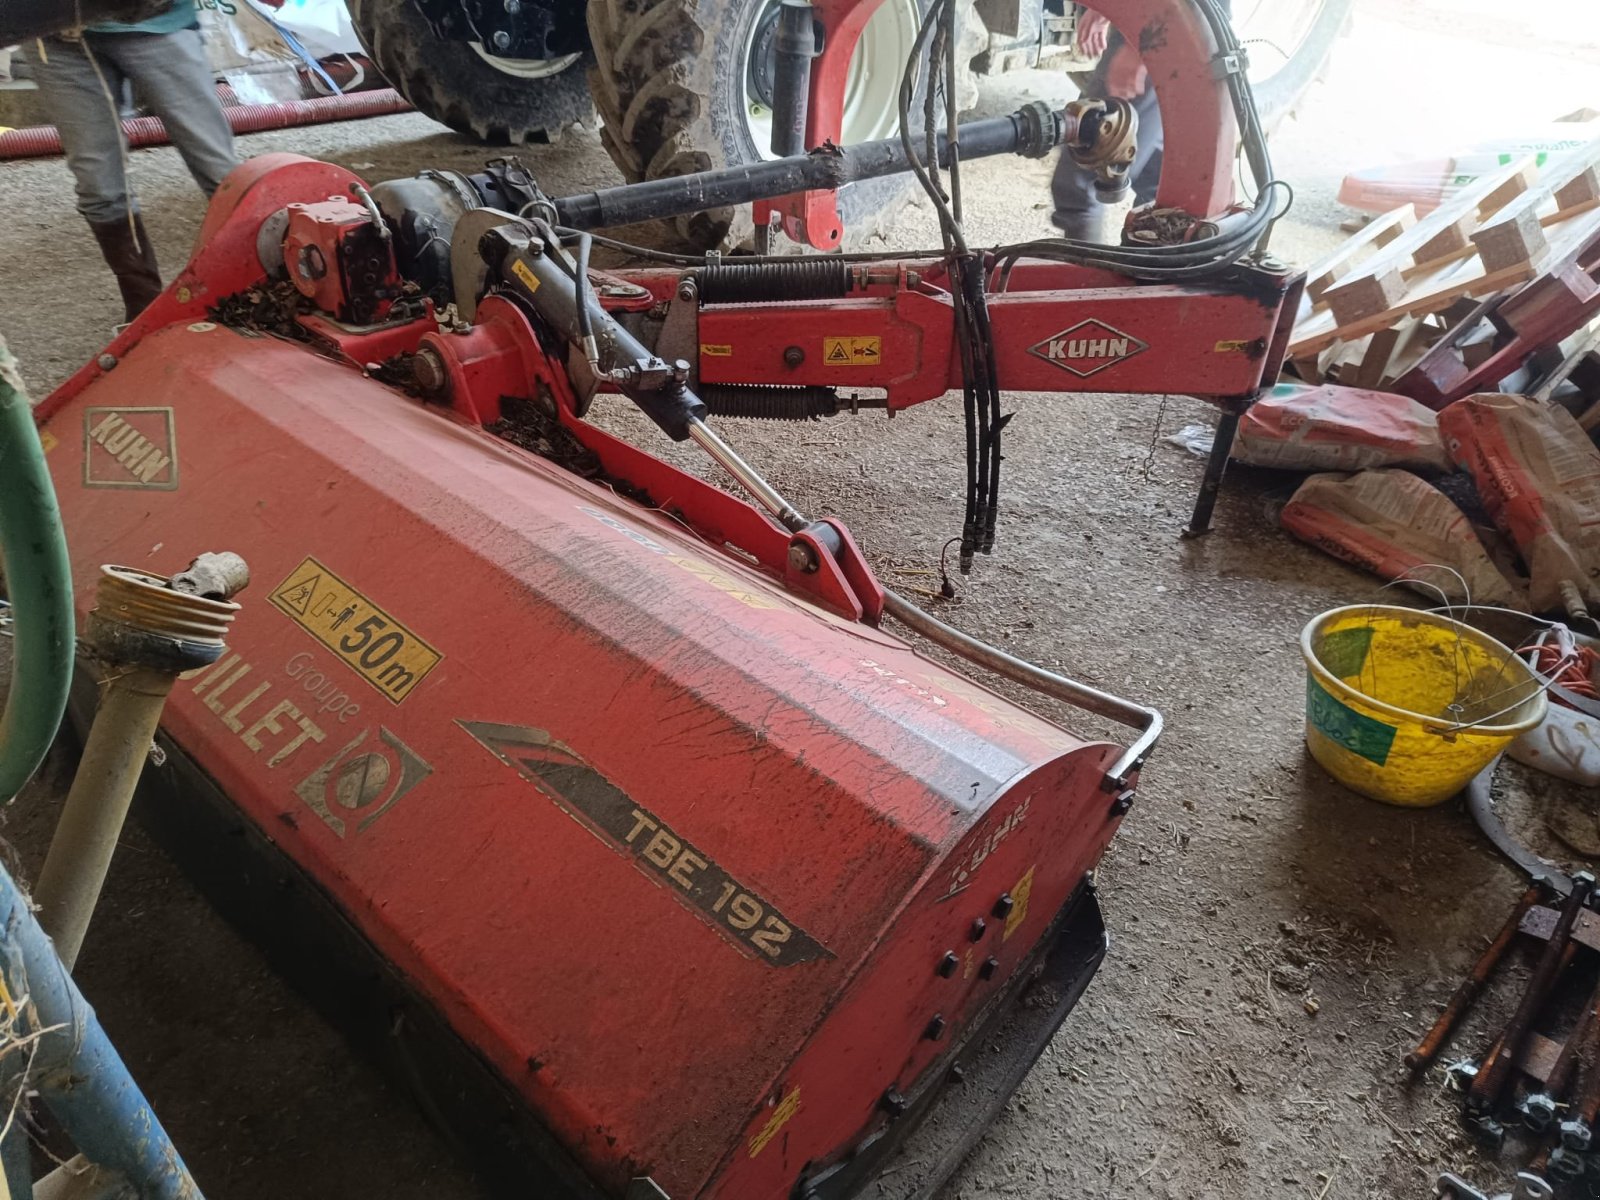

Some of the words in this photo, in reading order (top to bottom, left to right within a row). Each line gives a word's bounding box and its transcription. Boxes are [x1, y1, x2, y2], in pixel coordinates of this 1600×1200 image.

[1048, 338, 1129, 359] KUHN
[89, 411, 171, 484] KUHN
[285, 651, 361, 724] Groupe
[625, 808, 709, 890] TBE
[712, 881, 793, 957] 192
